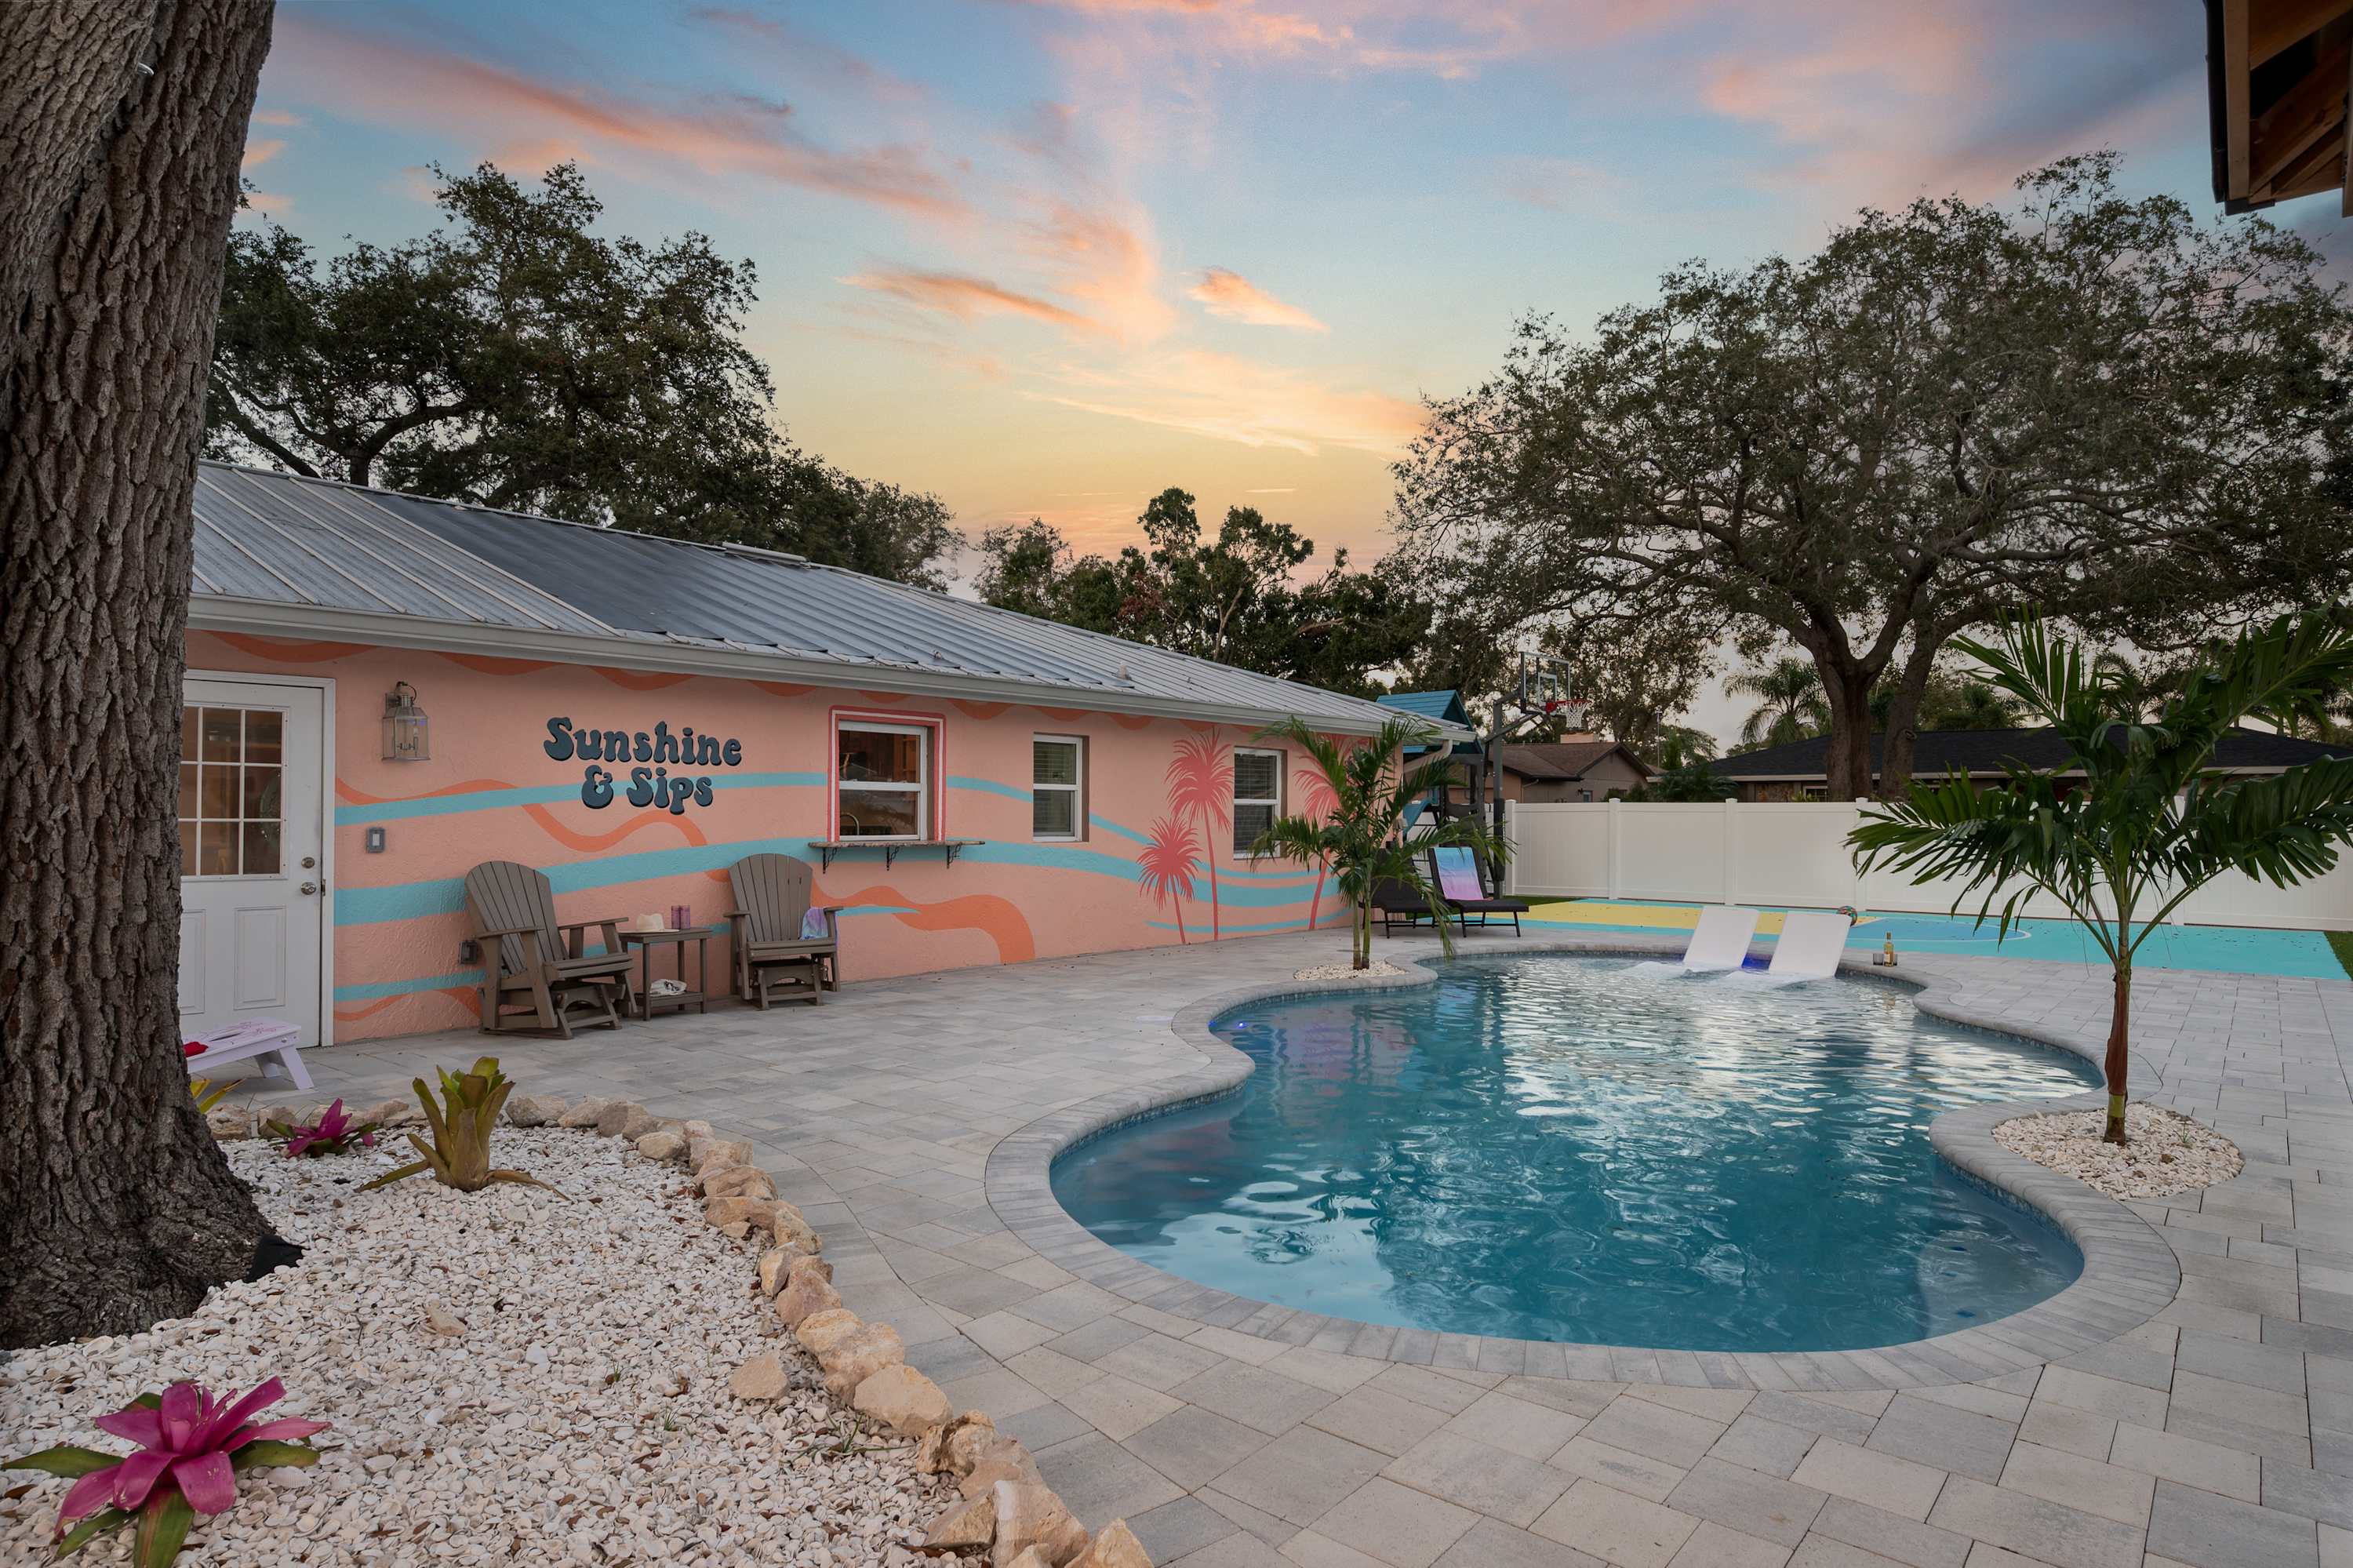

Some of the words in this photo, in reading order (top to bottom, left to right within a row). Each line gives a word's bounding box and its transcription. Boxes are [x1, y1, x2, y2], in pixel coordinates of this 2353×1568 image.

[543, 716, 742, 766] Sunshine
[580, 764, 614, 809] &
[626, 766, 714, 816] Sips
